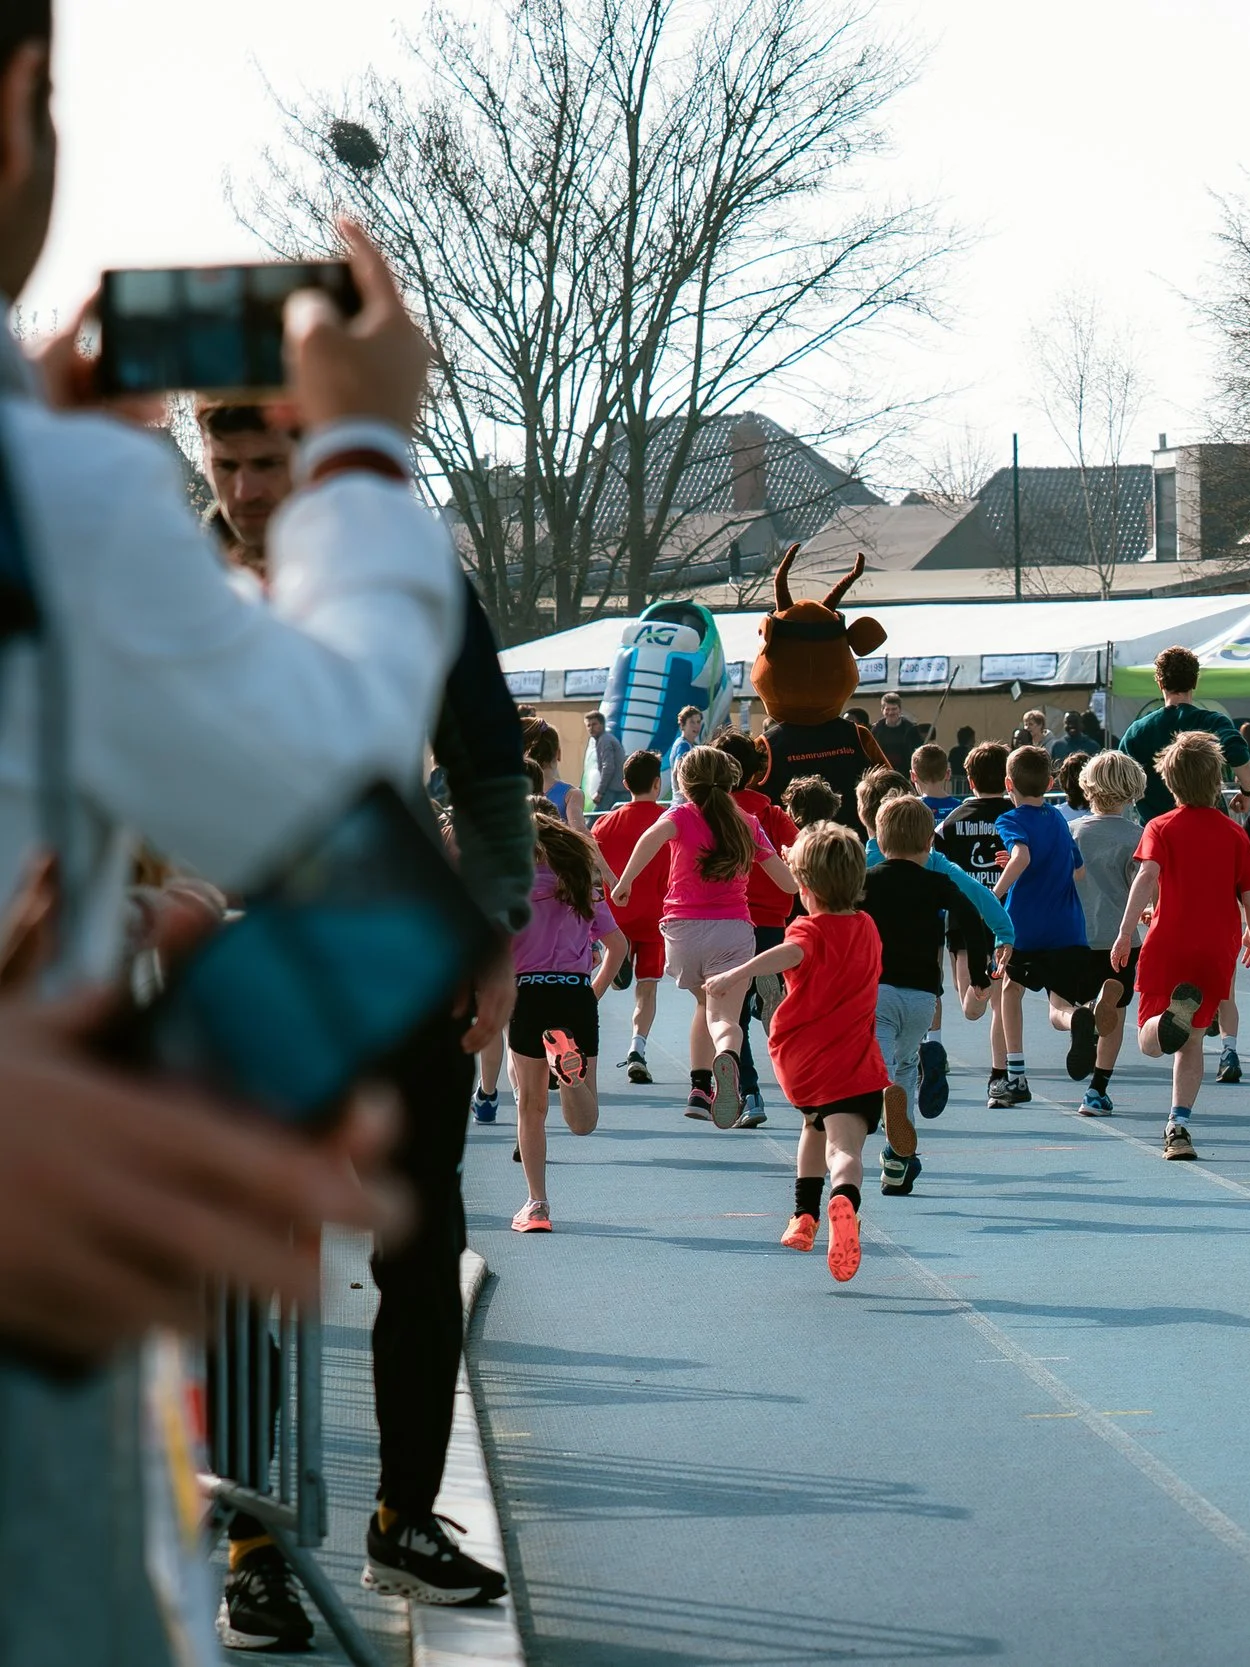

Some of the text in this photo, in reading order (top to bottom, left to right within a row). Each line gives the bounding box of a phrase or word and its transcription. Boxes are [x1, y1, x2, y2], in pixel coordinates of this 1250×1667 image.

[633, 625, 678, 646] AG
[956, 820, 1000, 837] W. Van Hoey
